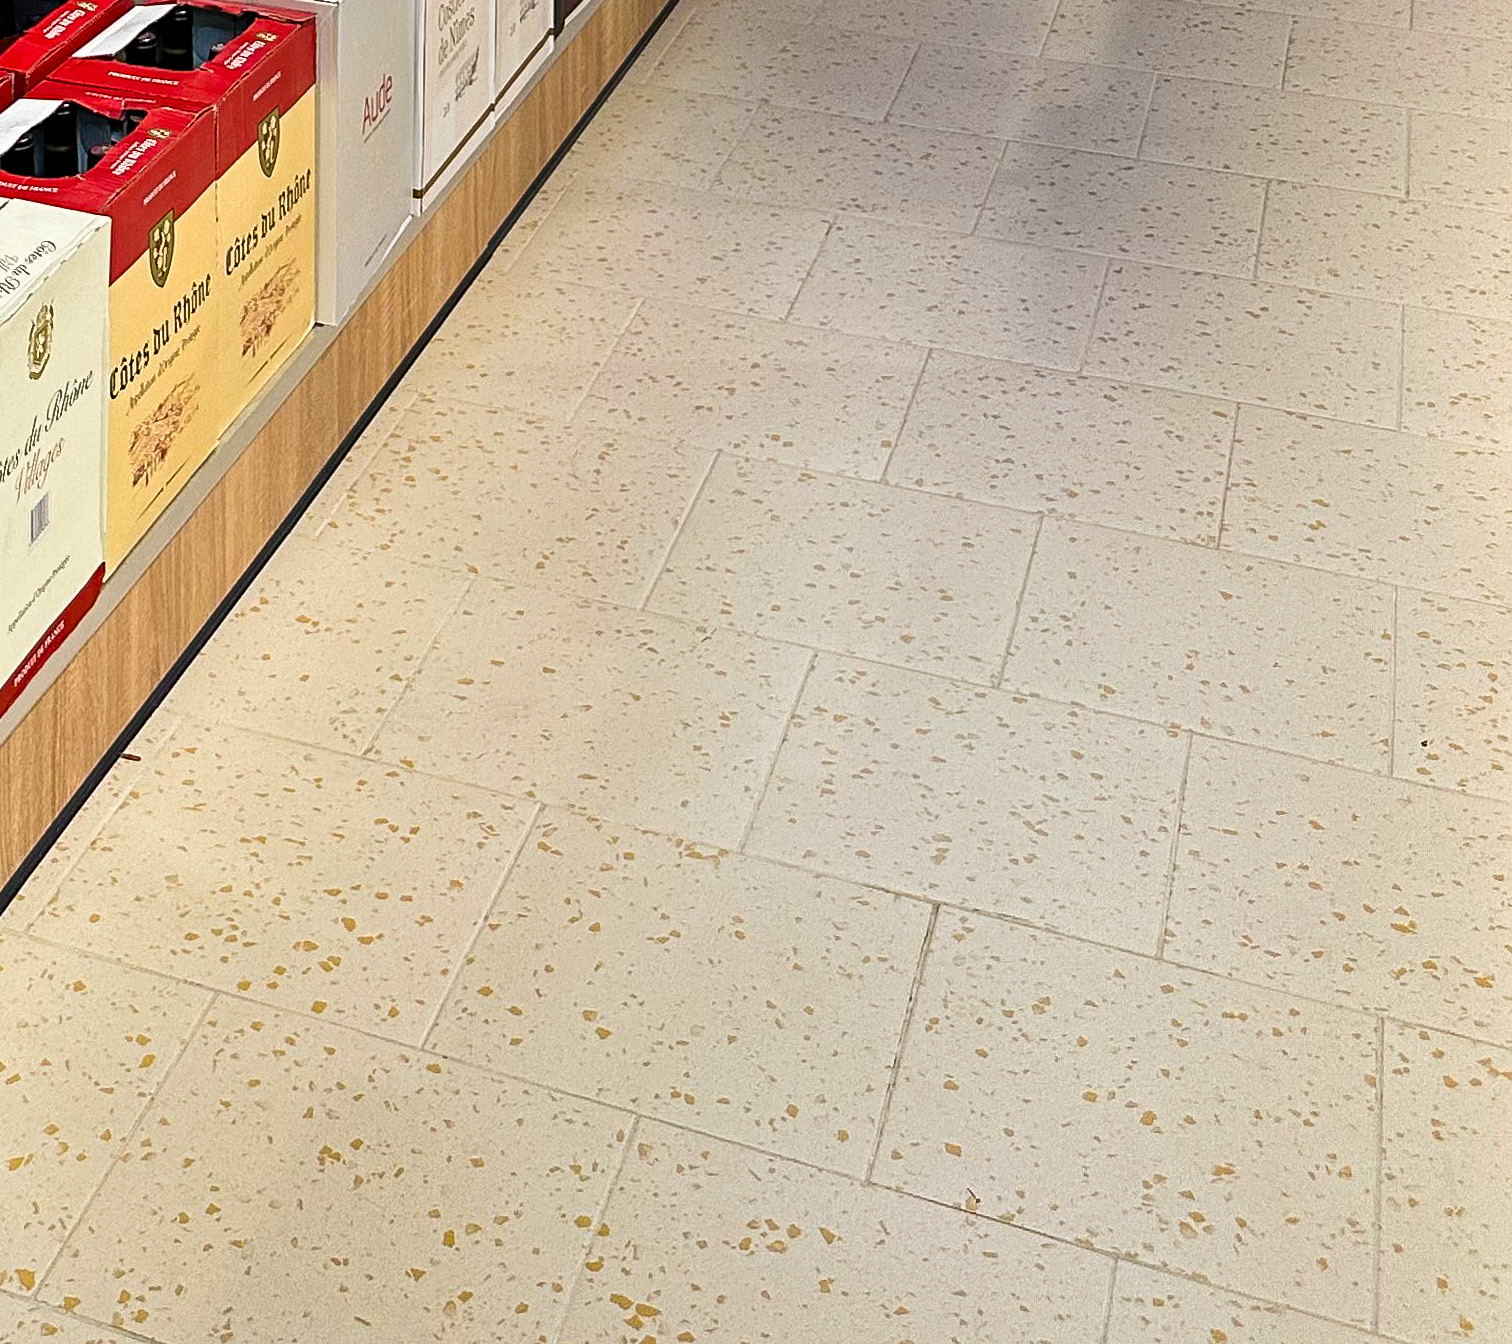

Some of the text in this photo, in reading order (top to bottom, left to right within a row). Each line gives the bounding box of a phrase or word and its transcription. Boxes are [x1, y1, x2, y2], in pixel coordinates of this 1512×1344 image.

[438, 7, 476, 65] de Nîmes
[361, 73, 393, 135] Aude
[226, 168, 312, 275] Côtes du Rhône
[109, 272, 212, 400] Côtes du Rhône
[24, 425, 44, 457] du
[47, 369, 94, 438] Rhône
[14, 436, 66, 502] Villages
